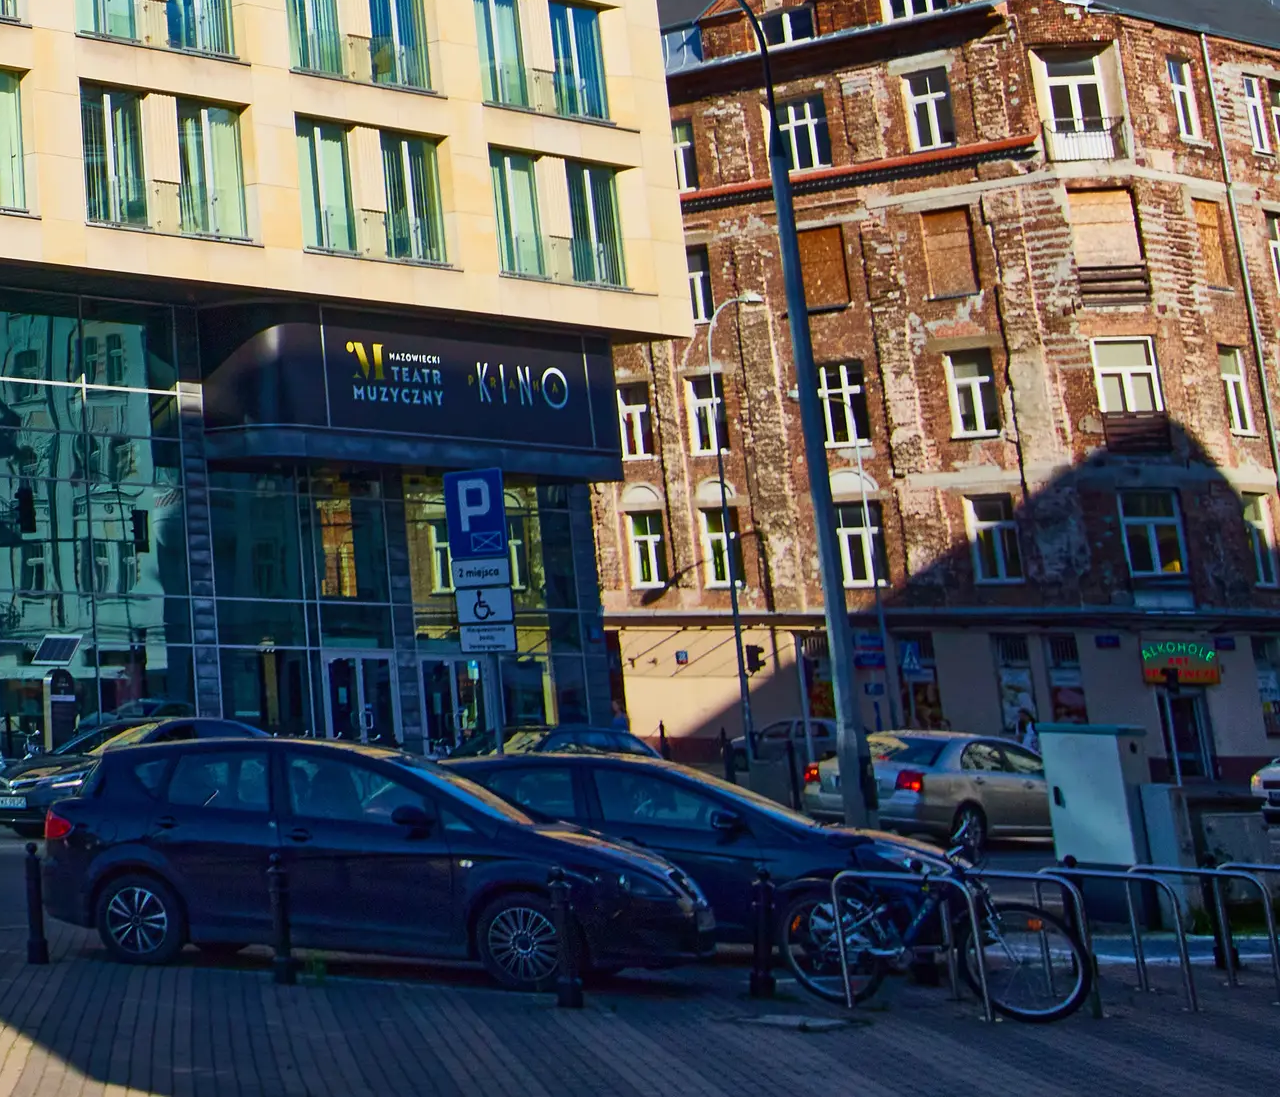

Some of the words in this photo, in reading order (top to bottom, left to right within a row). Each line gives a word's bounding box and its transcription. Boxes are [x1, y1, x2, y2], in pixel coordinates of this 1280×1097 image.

[389, 352, 441, 366] MAZOWIECKI
[391, 365, 442, 385] TEATR
[476, 361, 569, 410] KINO
[352, 384, 444, 406] MUZYCZNY
[457, 478, 490, 532] P
[458, 568, 464, 578] 2
[465, 566, 500, 580] miejsca
[1141, 641, 1216, 663] ALKOHOLE
